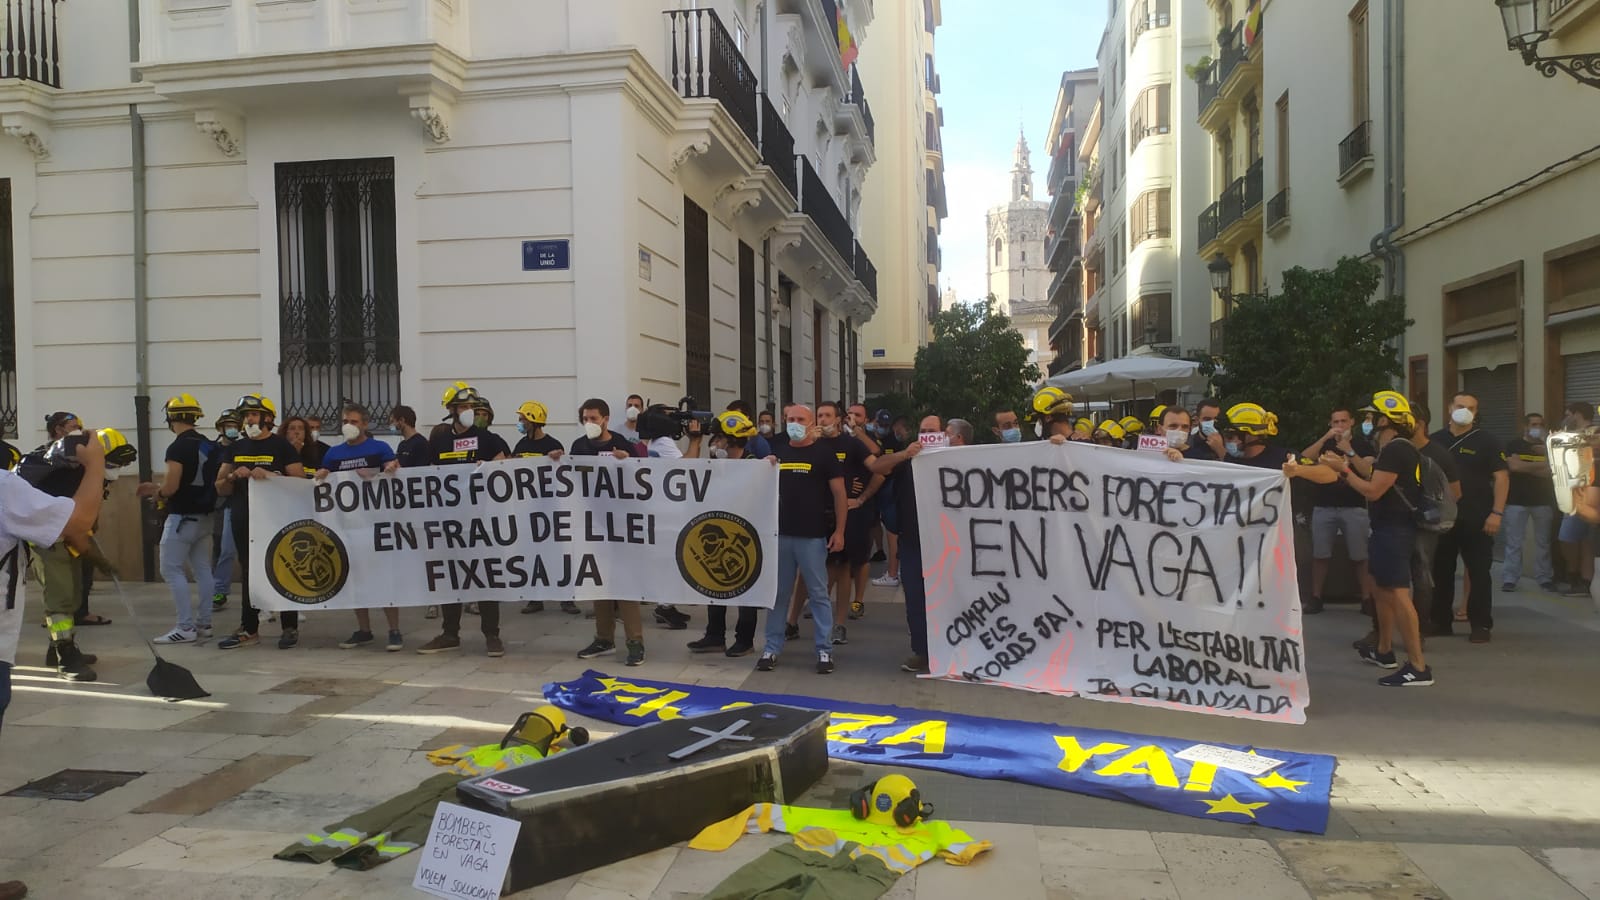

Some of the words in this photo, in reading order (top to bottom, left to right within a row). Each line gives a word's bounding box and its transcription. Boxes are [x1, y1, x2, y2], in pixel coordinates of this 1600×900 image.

[314, 474, 461, 513] BOMBERS
[469, 465, 652, 506] FORESTALS
[663, 469, 712, 503] GV
[939, 466, 1090, 511] BOMBERS
[1103, 474, 1283, 527] FORESTALS
[374, 521, 418, 551] EN
[423, 515, 518, 550] FRAU
[530, 511, 572, 543] DE
[585, 511, 656, 544] LLEI
[970, 517, 1047, 580] EN
[425, 554, 550, 591] FIXESA
[557, 554, 603, 587] JA
[962, 632, 1036, 682] ACORDS
[1033, 594, 1084, 639] JA!
[978, 616, 1017, 650] ELS
[1096, 618, 1151, 651] PER
[1157, 620, 1301, 673] L'ESTABILITAT
[1086, 679, 1121, 695] JA
[1133, 653, 1270, 689] LABORAL
[435, 831, 496, 856] FORESTALS
[438, 812, 492, 839] BOMBERS
[420, 867, 447, 889] VOLEM
[433, 847, 448, 859] EN
[460, 853, 489, 873] VAGA
